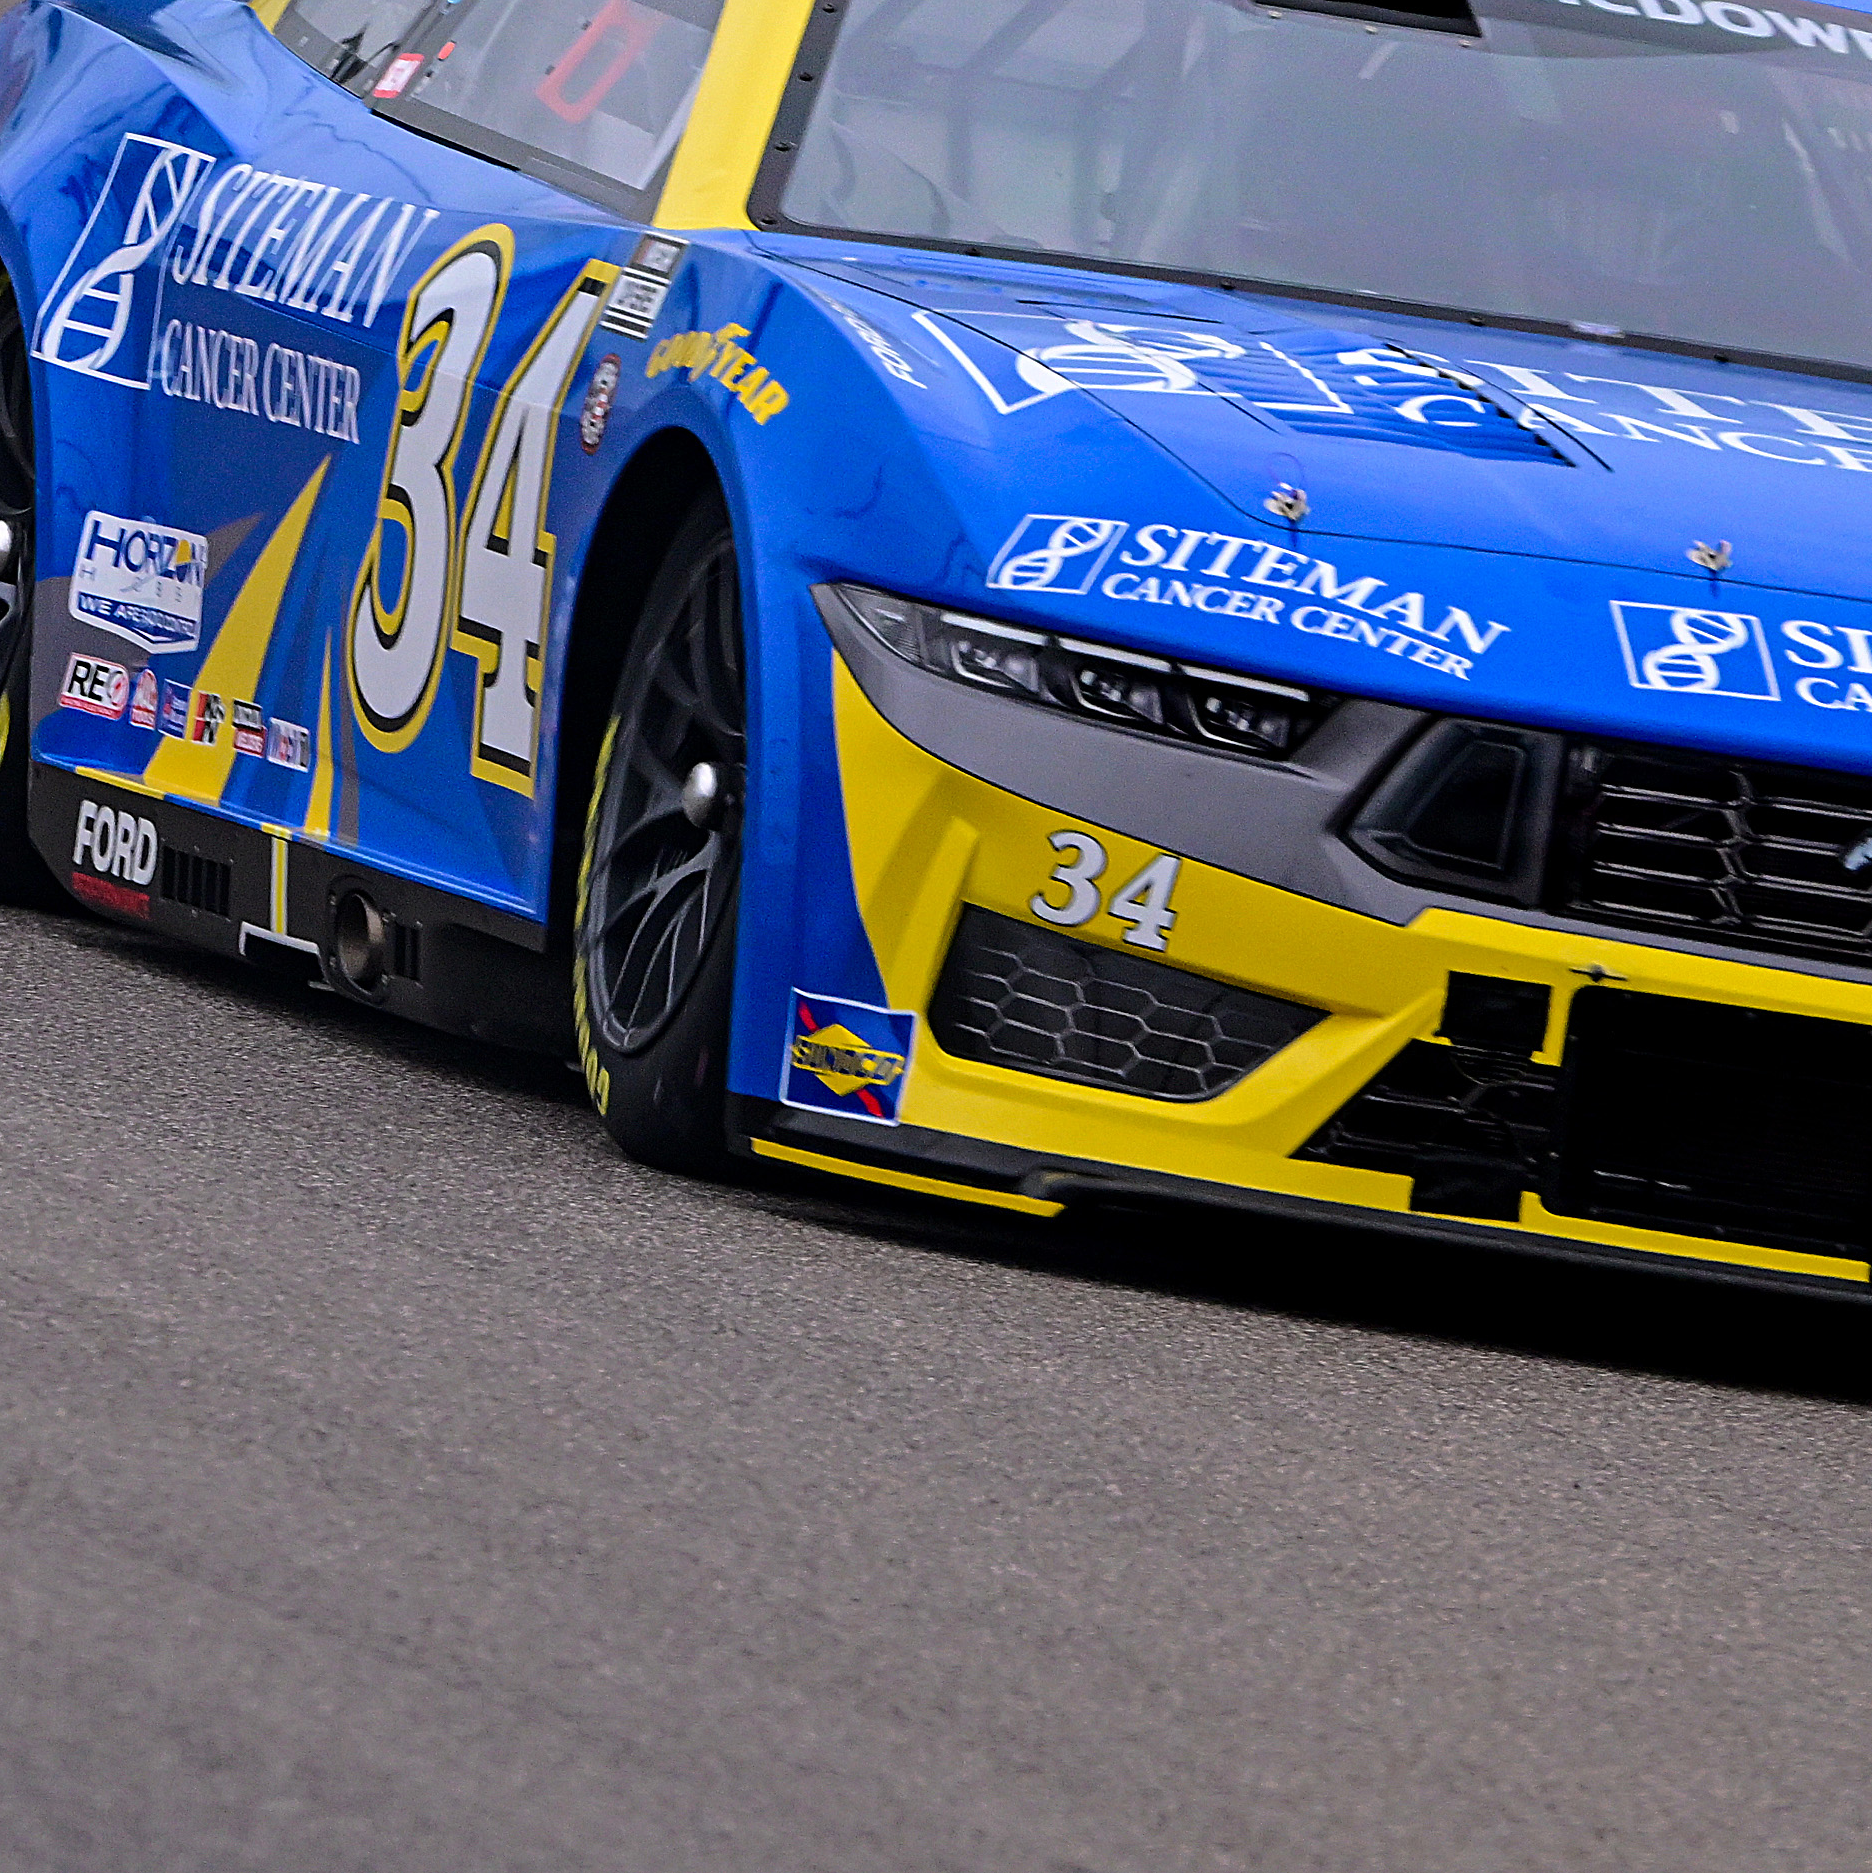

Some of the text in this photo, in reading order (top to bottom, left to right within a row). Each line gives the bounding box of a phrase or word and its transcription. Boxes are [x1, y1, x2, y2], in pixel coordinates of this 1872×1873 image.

[172, 164, 440, 328] SITEMAN
[162, 319, 360, 444] CANCER CENTER
[346, 223, 622, 800] 34
[1102, 572, 1473, 681] CANCER CENTER
[1119, 523, 1511, 654] SITEMAN
[73, 799, 159, 885] FORD
[1029, 829, 1182, 953] 34
